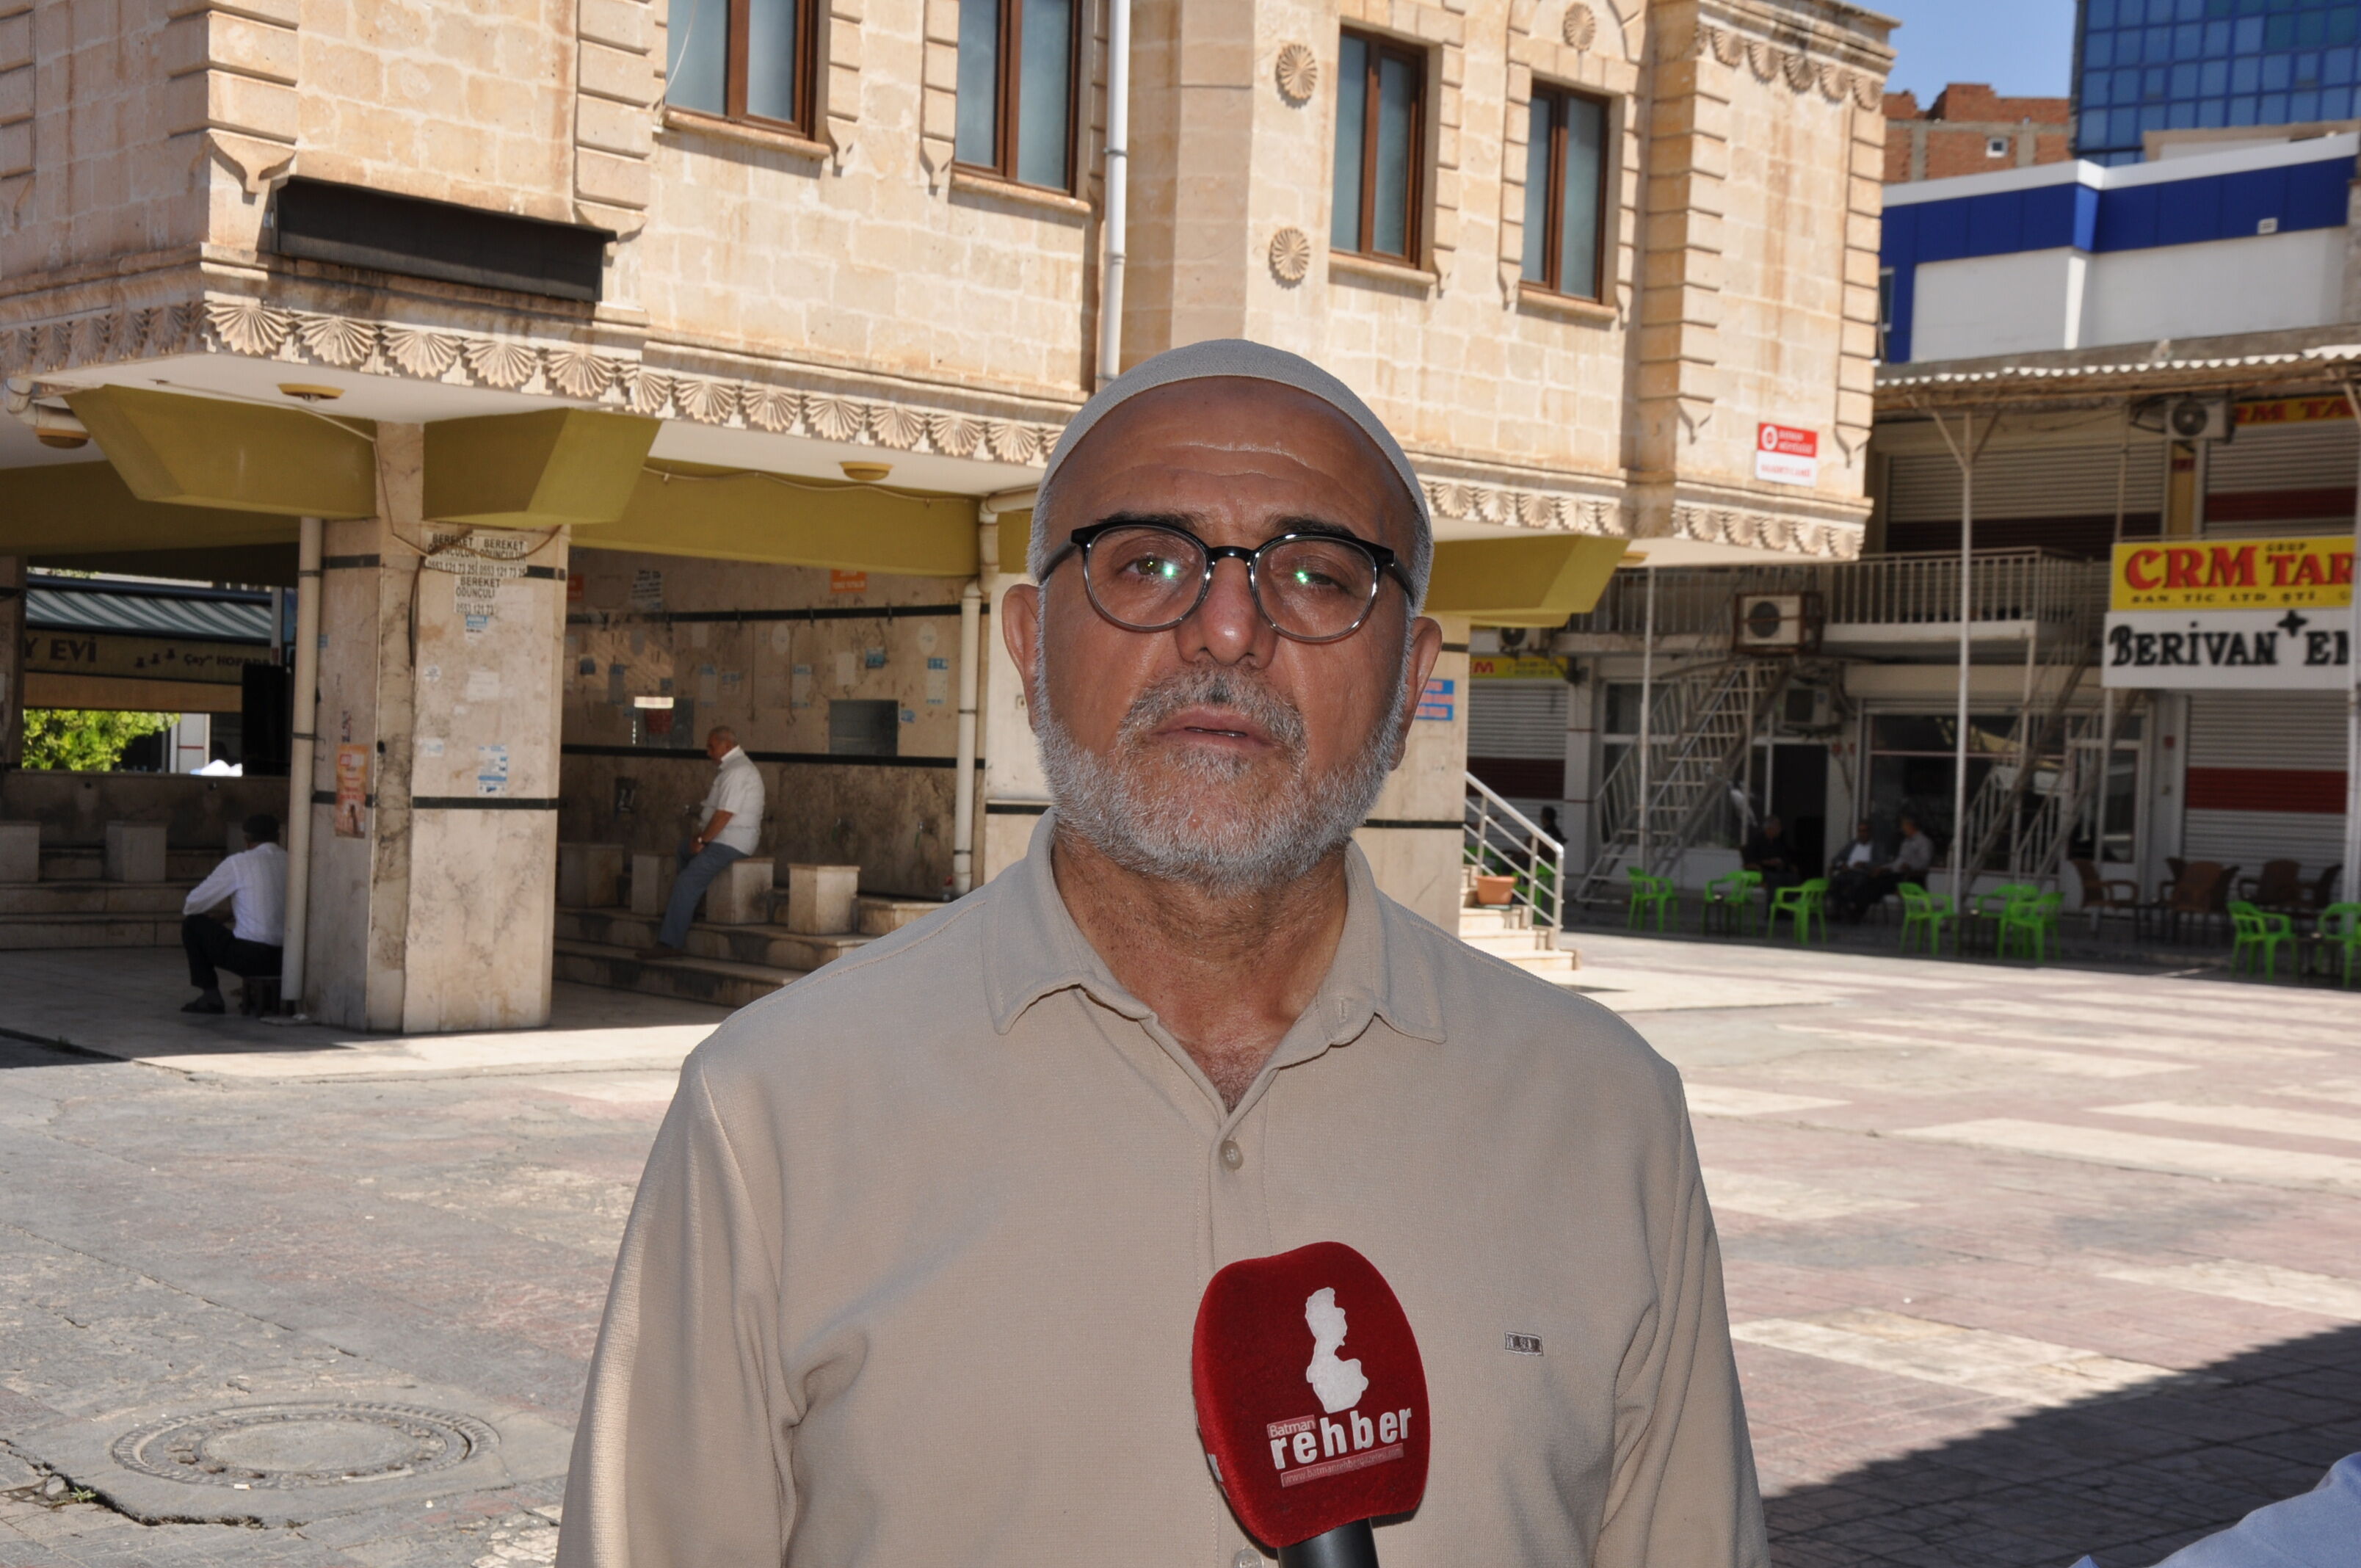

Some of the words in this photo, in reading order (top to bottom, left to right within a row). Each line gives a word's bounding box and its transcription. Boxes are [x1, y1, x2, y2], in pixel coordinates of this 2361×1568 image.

[432, 534, 474, 547] BEREKET
[484, 538, 523, 550] BEREKET
[2125, 545, 2257, 589] CRM
[460, 577, 500, 588] BEREKET
[50, 636, 96, 662] EVİ
[2109, 620, 2278, 666] BERİVAN
[1269, 1419, 1316, 1438] Batman
[1270, 1408, 1412, 1470] rehber
